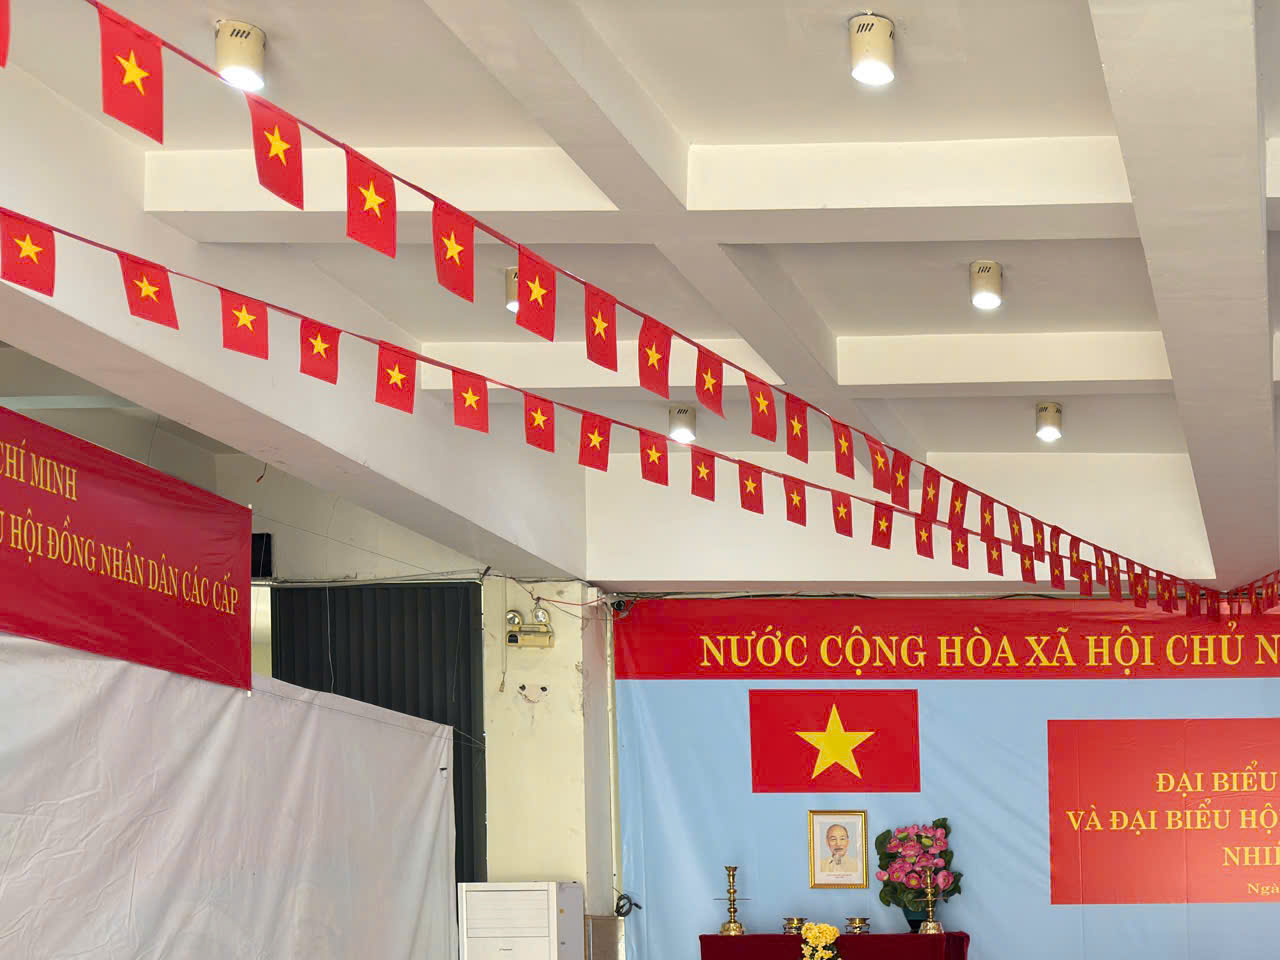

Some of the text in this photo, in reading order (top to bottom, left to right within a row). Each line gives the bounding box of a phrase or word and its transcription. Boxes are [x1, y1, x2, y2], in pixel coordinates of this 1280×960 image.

[30, 452, 78, 501] MINH
[9, 507, 43, 563] HỘI
[47, 514, 97, 572] ĐỒNG
[99, 541, 145, 586] NHÂN
[148, 553, 179, 598] DÂN
[182, 564, 209, 607] CÁC
[212, 571, 239, 615] CẤP
[700, 624, 809, 668] NƯỚC
[819, 625, 928, 677] CỘNG
[936, 625, 1018, 668] HÒA
[1025, 626, 1077, 667] XÃ
[1085, 624, 1155, 676] HỘI
[1165, 621, 1245, 666] CHỦ
[1156, 771, 1205, 798] ĐẠI
[1211, 760, 1278, 792] BIỂU
[1066, 804, 1104, 831] VÀ
[1109, 809, 1158, 836] ĐẠI
[1165, 798, 1231, 830] BIỂU
